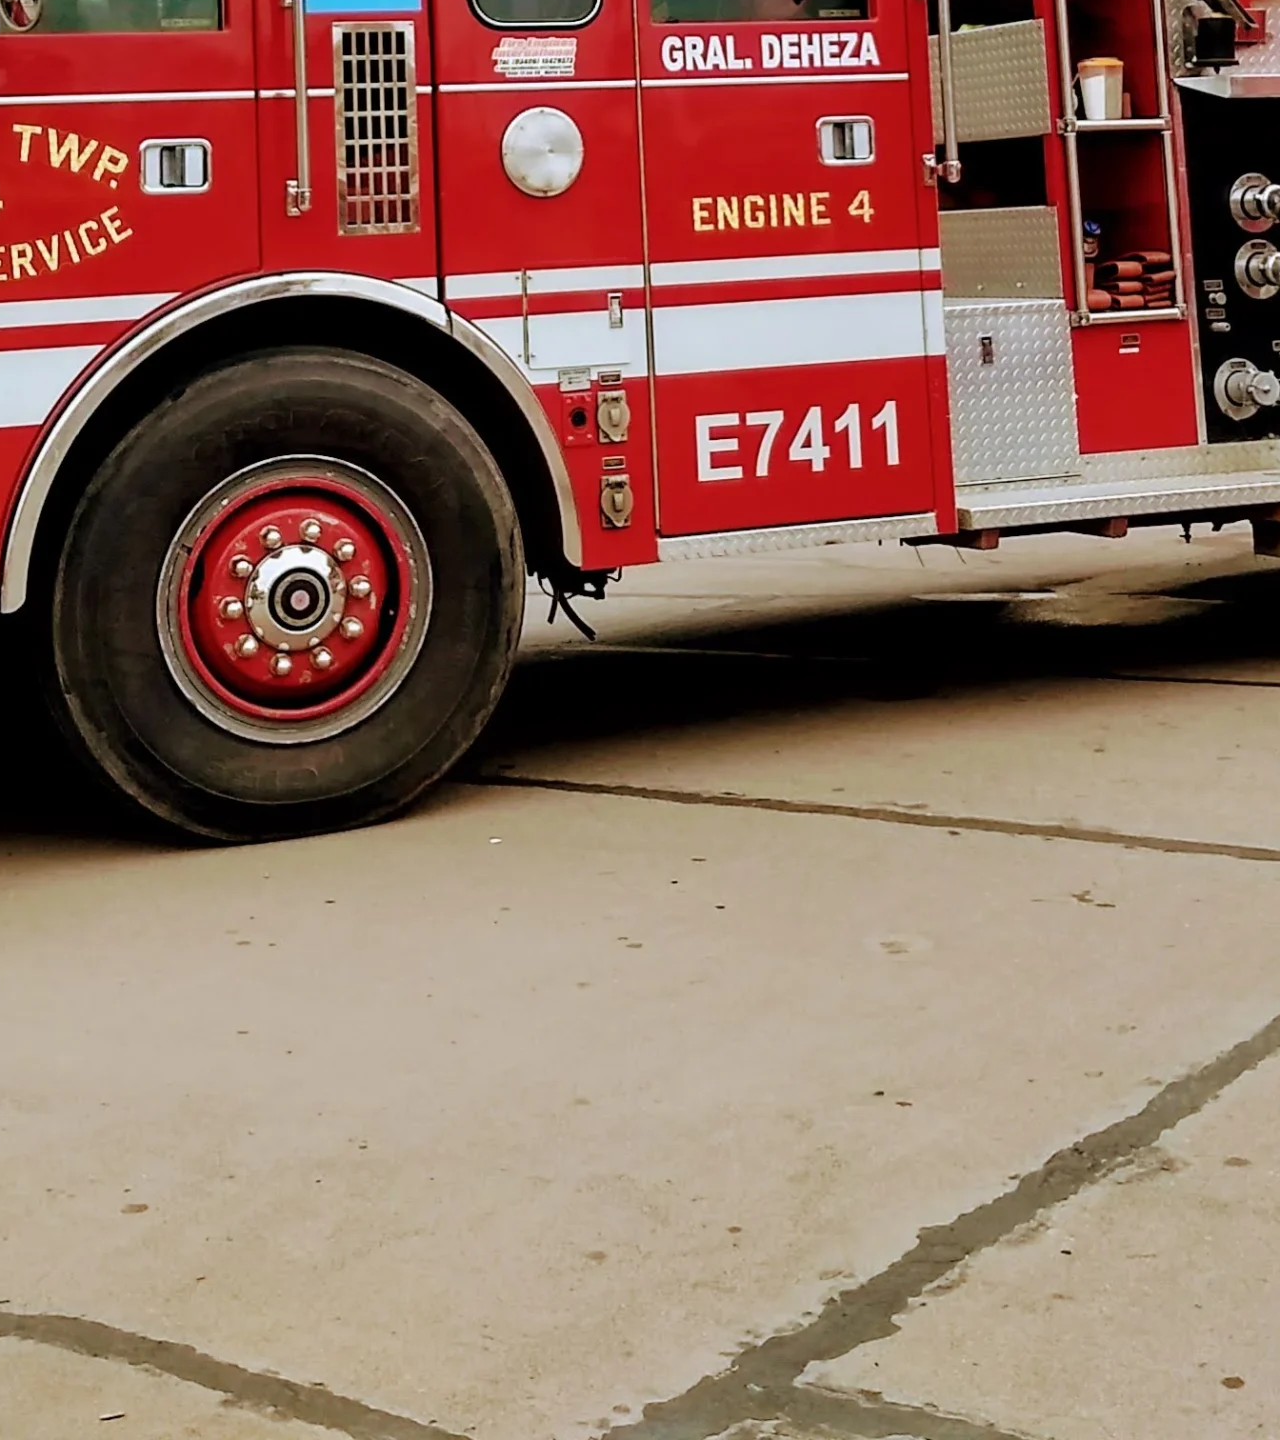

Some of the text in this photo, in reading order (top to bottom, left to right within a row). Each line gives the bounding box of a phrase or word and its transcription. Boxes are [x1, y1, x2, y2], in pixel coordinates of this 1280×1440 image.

[661, 32, 881, 71] GRAL. DEHEZA
[12, 123, 129, 189] TWP.
[692, 190, 875, 231] ENGINE 4
[695, 400, 900, 482] E7411
